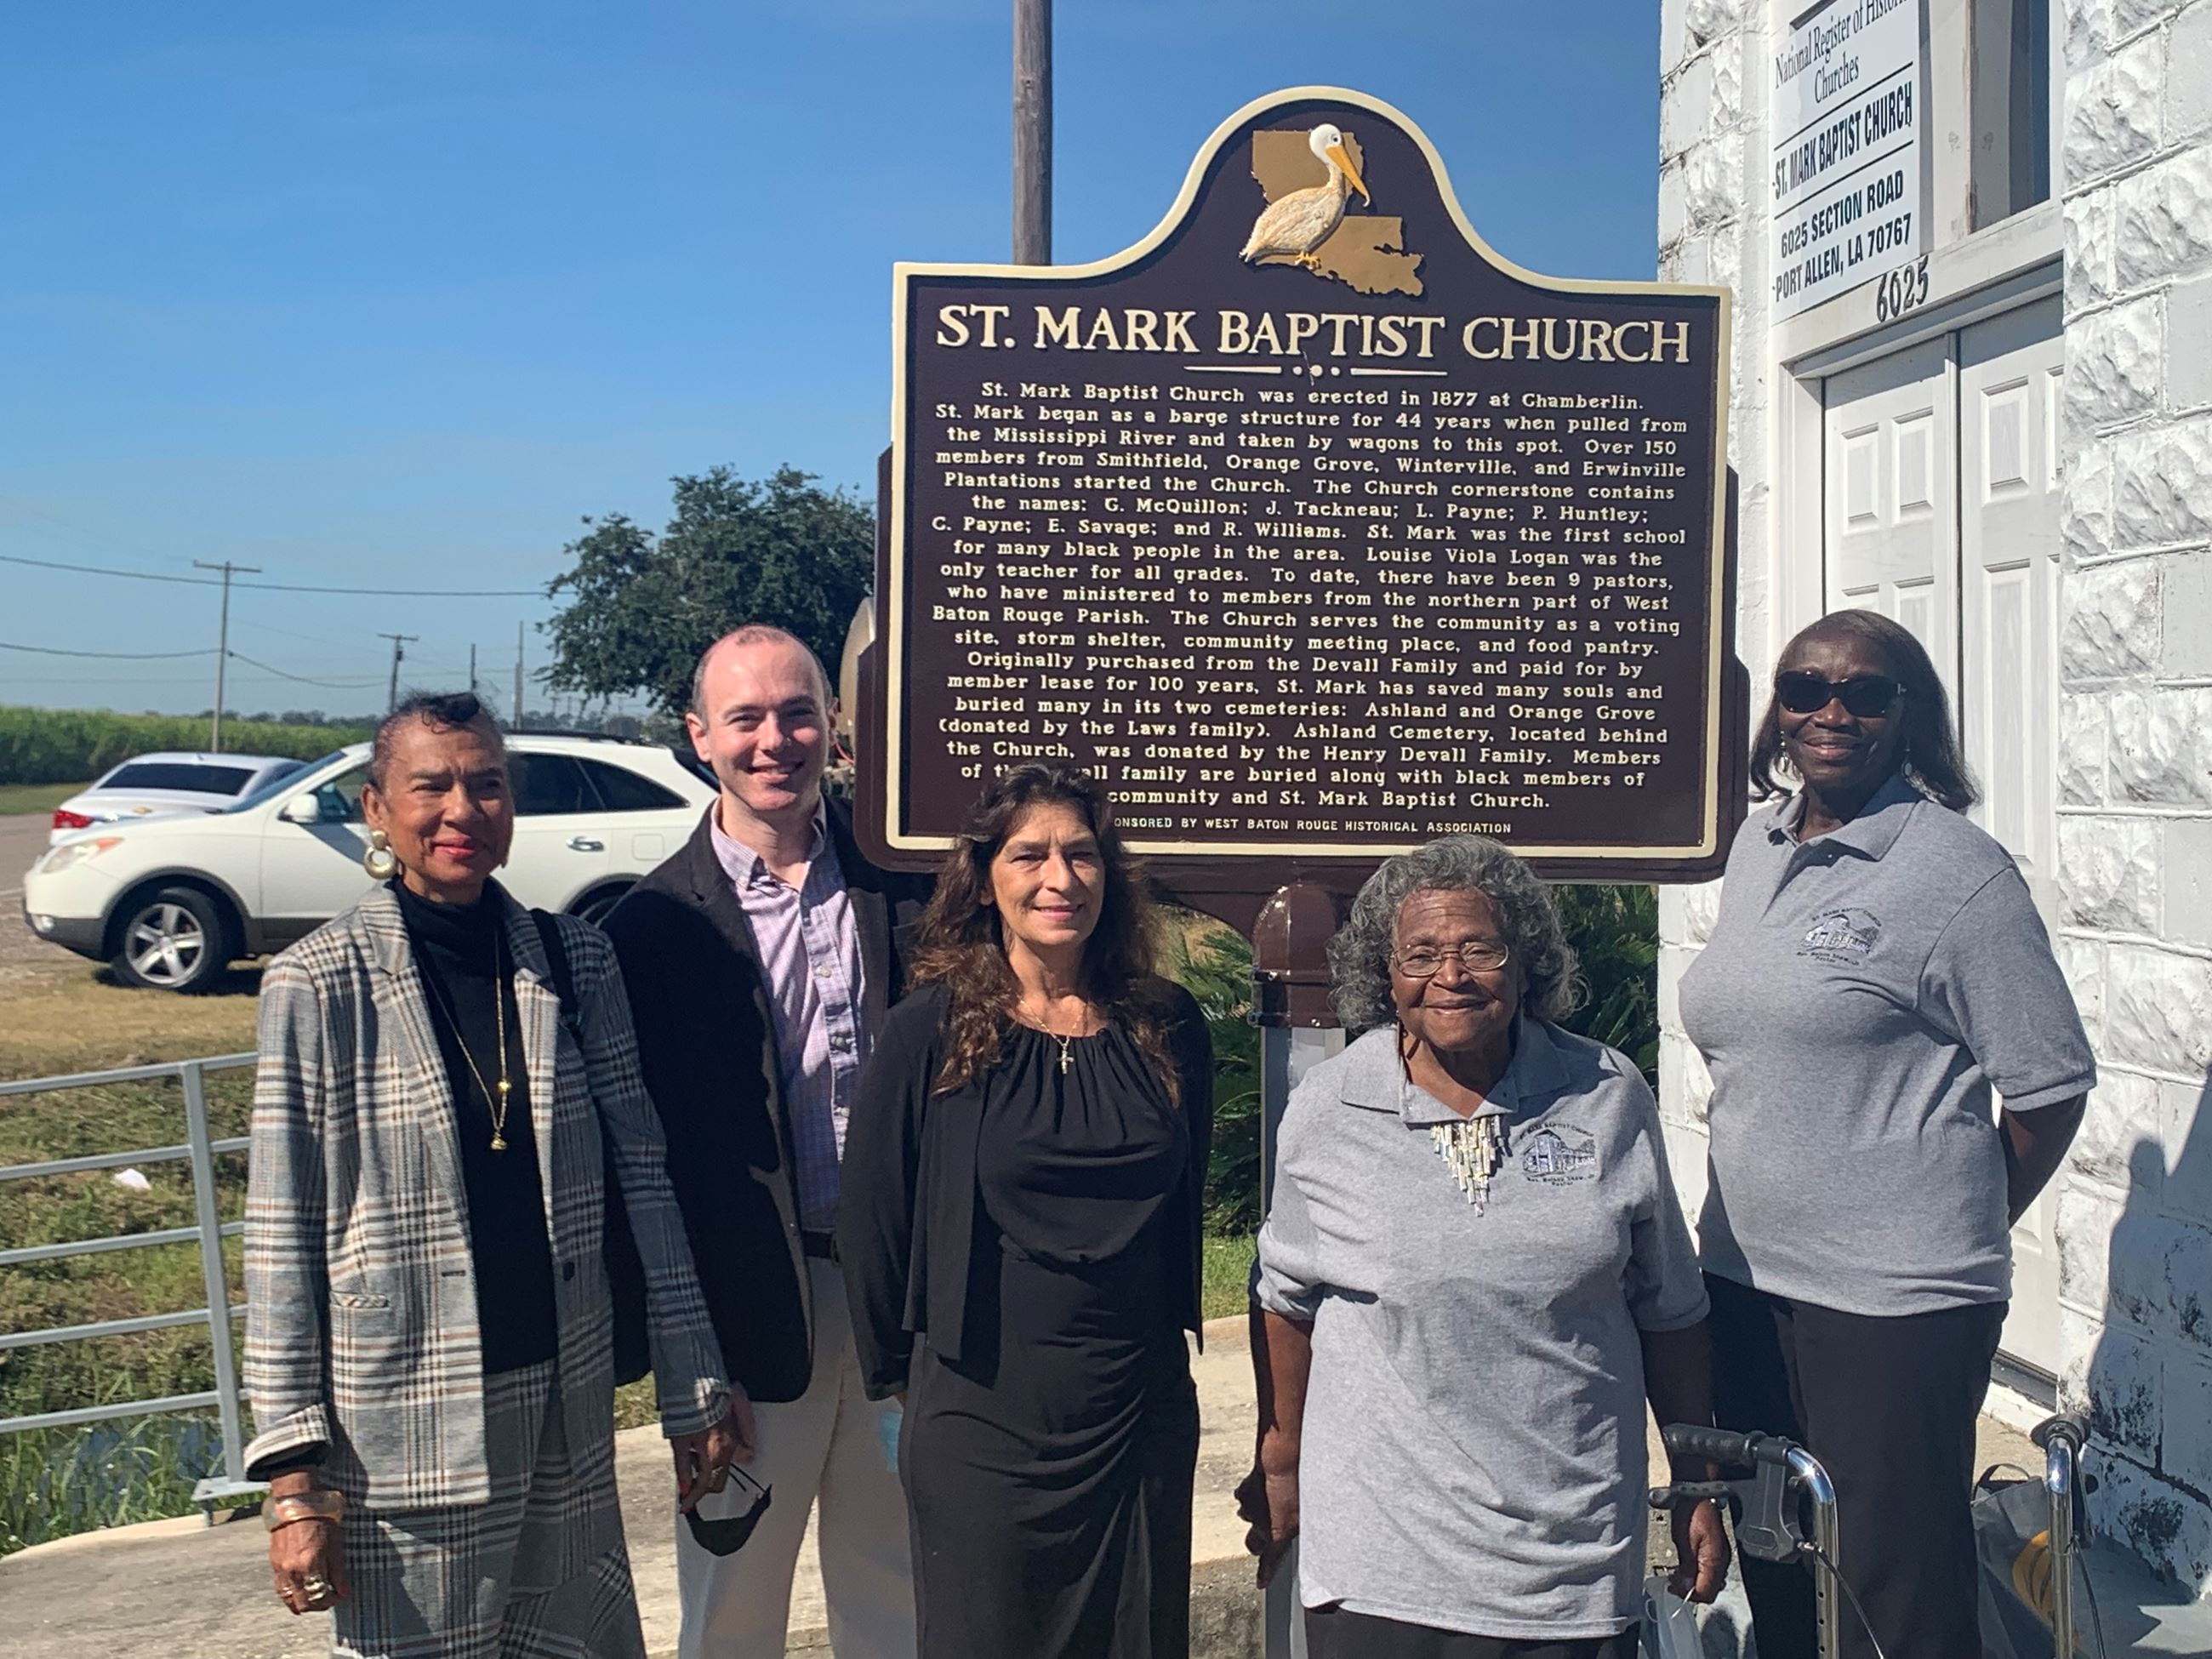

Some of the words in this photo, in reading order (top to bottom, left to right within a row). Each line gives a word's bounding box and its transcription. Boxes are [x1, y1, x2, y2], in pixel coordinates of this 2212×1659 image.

[1775, 31, 1812, 88] National
[1813, 14, 1851, 64] Register
[1853, 0, 1863, 33] of
[1815, 51, 1859, 103] Churches
[1775, 157, 1787, 200] ST.
[1790, 137, 1817, 191] MARK
[1819, 110, 1861, 173] BAPTIST
[1865, 81, 1913, 146] CHURCH
[1782, 221, 1808, 258] 6025
[1811, 190, 1862, 242] SECTION
[1867, 170, 1903, 214] ROAD
[1776, 264, 1802, 302] PORT
[1804, 245, 1844, 277] ALLEN,
[1848, 234, 1863, 266] LA
[1867, 213, 1912, 258] 70767
[1877, 255, 1929, 322] 6025
[937, 304, 1016, 348] ST.
[1034, 306, 1200, 353] MARK
[1217, 311, 1445, 358] BAPTIST
[1462, 316, 1690, 363] CHURCH
[981, 382, 1008, 397] St.
[1019, 382, 1071, 399] Mark
[1083, 384, 1160, 402] Baptist
[1169, 385, 1245, 402] Church
[1257, 390, 1294, 403] was
[1308, 390, 1389, 406] erected
[1400, 390, 1421, 407] in
[1431, 391, 1478, 408] 1877
[1488, 392, 1510, 408] at
[1521, 392, 1644, 409] Chamberlin.
[935, 403, 962, 419] St.
[973, 404, 1025, 419] Mark
[1037, 405, 1098, 425] began
[1110, 410, 1132, 423] as
[1144, 411, 1156, 423] a
[1168, 408, 1228, 428] barge
[1240, 409, 1340, 426] structure
[1352, 412, 1382, 427] for
[1394, 412, 1422, 428] 44
[1434, 416, 1491, 430] years
[1503, 416, 1556, 430] when
[1566, 416, 1629, 434] pulled
[1641, 417, 1687, 433] from
[935, 448, 1025, 465] members
[1037, 450, 1084, 466] from
[1096, 452, 1209, 470] Smithfield,
[1226, 453, 1301, 474] Orange
[1313, 456, 1380, 474] Grove,
[1395, 457, 1517, 476] Winterville,
[1534, 460, 1570, 476] and
[1582, 460, 1685, 477] Erwinville
[944, 470, 1061, 489] Plantations
[1073, 474, 1151, 491] started
[1163, 476, 1197, 491] the
[1211, 477, 1291, 493] Church.
[1313, 479, 1352, 494] The
[1364, 479, 1439, 496] Church
[1451, 483, 1575, 498] cornerstone
[1588, 484, 1675, 499] contains
[932, 516, 952, 532] C.
[962, 516, 1032, 534] Payne;
[1047, 518, 1066, 533] E.
[1078, 518, 1157, 539] Savage;
[1173, 522, 1211, 536] and
[1223, 522, 1243, 537] R.
[1253, 522, 1347, 539] Williams.
[1366, 523, 1394, 539] St.
[1406, 524, 1457, 540] Mark
[1469, 528, 1507, 542] was
[1518, 527, 1553, 542] the
[1564, 527, 1611, 543] first
[1622, 528, 1685, 544] school
[940, 561, 986, 579] only
[996, 562, 1079, 579] teacher
[1090, 564, 1122, 579] for
[1134, 564, 1161, 580] all
[1173, 566, 1249, 584] grades.
[1270, 567, 1296, 583] To
[1309, 568, 1360, 586] date,
[1377, 569, 1434, 584] there
[1446, 571, 1495, 586] have
[1507, 571, 1556, 587] been
[1568, 572, 1581, 587] 9
[1593, 573, 1673, 591] pastors,
[932, 605, 990, 622] Baton
[1003, 607, 1064, 627] Rouge
[1076, 607, 1149, 624] Parish.
[1170, 610, 1209, 625] The
[1223, 610, 1297, 627] Church
[1309, 615, 1378, 628] serves
[1391, 613, 1425, 629] the
[1437, 615, 1545, 633] community
[1556, 619, 1578, 631] as
[1588, 620, 1600, 632] a
[1614, 618, 1680, 637] voting
[954, 629, 1000, 646] site,
[1017, 630, 1075, 646] storm
[1086, 631, 1166, 649] shelter,
[1183, 634, 1294, 652] community
[1307, 636, 1388, 654] meeting
[1400, 636, 1461, 654] place,
[1478, 637, 1515, 653] and
[1527, 637, 1571, 653] food
[1583, 639, 1659, 658] pantry.
[947, 673, 1029, 689] member
[1040, 674, 1095, 690] lease
[1105, 676, 1138, 692] for
[1149, 676, 1183, 692] 100
[1195, 680, 1260, 695] years,
[1277, 678, 1304, 693] St.
[1314, 678, 1367, 695] Mark
[1379, 680, 1415, 695] has
[1427, 681, 1483, 697] saved
[1495, 685, 1549, 700] many
[1563, 683, 1614, 698] souls
[1626, 685, 1663, 699] and
[954, 696, 1024, 712] buried
[1037, 700, 1092, 715] many
[1102, 698, 1123, 714] in
[1134, 698, 1161, 714] its
[1173, 699, 1212, 715] two
[1224, 700, 1347, 717] cemeteries:
[1364, 702, 1447, 717] Ashland
[1459, 704, 1496, 719] and
[1508, 704, 1583, 723] Orange
[1595, 705, 1656, 721] Grove
[945, 739, 981, 756] the
[993, 741, 1075, 759] Church,
[1093, 745, 1131, 758] was
[1144, 743, 1229, 760] donated
[1240, 744, 1265, 762] by
[1275, 744, 1311, 760] the
[1323, 744, 1388, 763] Henry
[1400, 746, 1466, 763] Devall
[1479, 748, 1553, 766] Family.
[1573, 749, 1662, 765] Members
[1107, 789, 1220, 807] community
[1231, 790, 1268, 805] and
[1279, 790, 1306, 806] St.
[1318, 790, 1369, 806] Mark
[1381, 790, 1457, 811] Baptist
[1469, 792, 1549, 807] Church.
[1114, 817, 1173, 828] ONSORED
[1181, 818, 1197, 828] BY
[1204, 818, 1240, 830] WEST
[1246, 818, 1289, 830] BATON
[1296, 819, 1338, 831] ROUGE
[1345, 820, 1418, 833] HISTORICAL
[1426, 821, 1512, 834] ASSOCIATION
